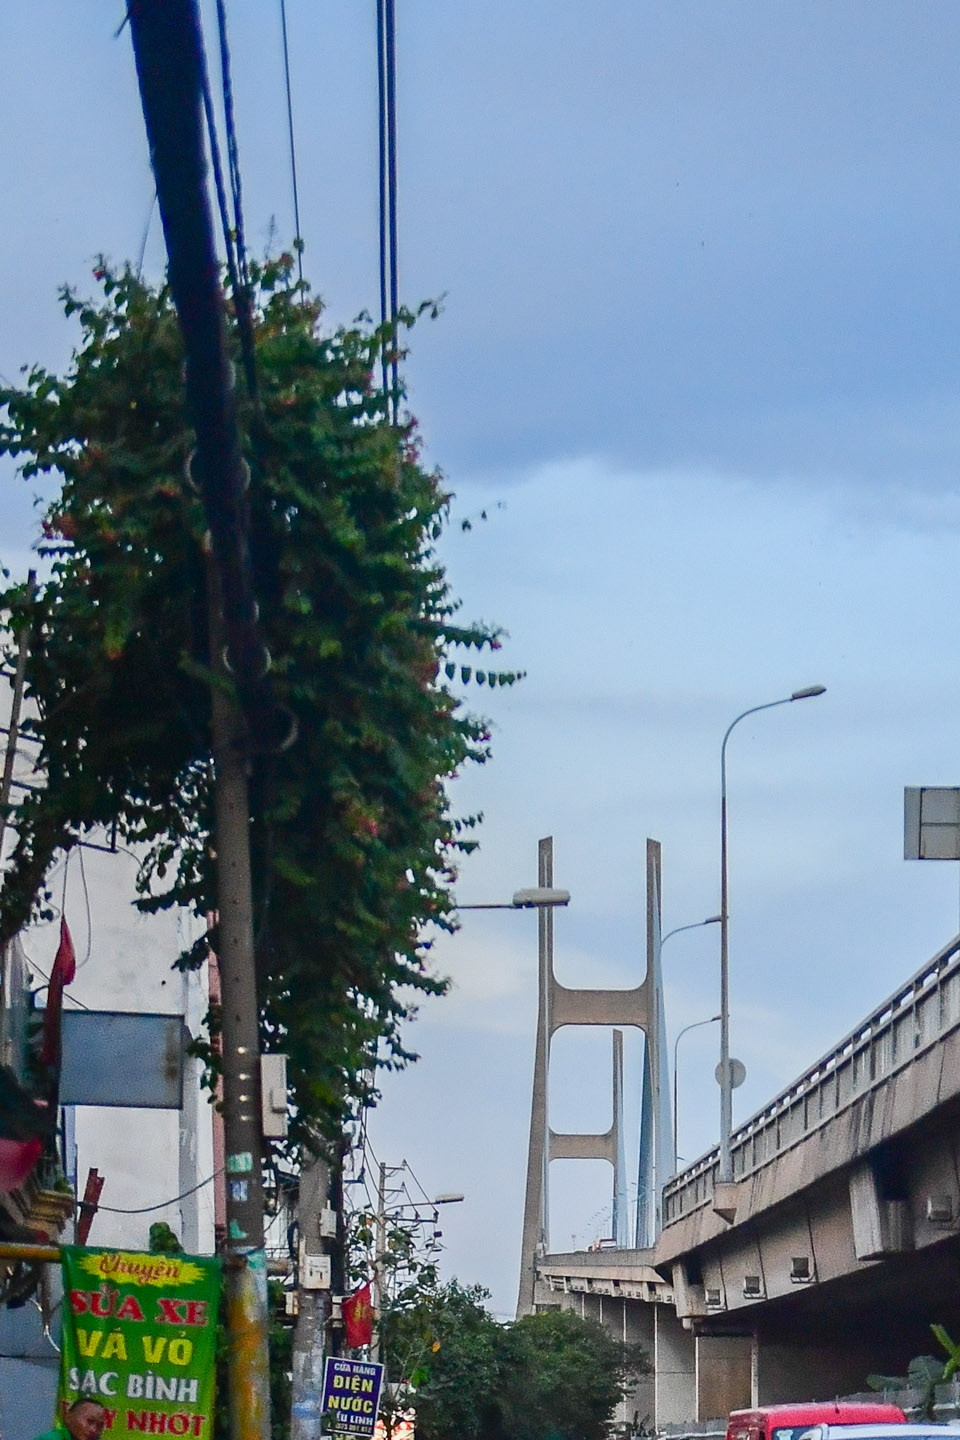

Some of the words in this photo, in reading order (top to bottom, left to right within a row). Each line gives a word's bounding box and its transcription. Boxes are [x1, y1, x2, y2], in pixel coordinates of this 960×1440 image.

[100, 1253, 180, 1285] Chuyên
[70, 1283, 145, 1321] SỬA
[155, 1298, 208, 1326] XE
[76, 1327, 128, 1361] VÁ
[142, 1330, 193, 1366] VỎ
[334, 1361, 351, 1373] CỬA
[353, 1364, 376, 1376] HÀNG
[69, 1367, 119, 1398] SẠC
[127, 1370, 199, 1403] BÌNH
[333, 1374, 374, 1394] ĐIỆN
[328, 1395, 373, 1414] NƯỚC
[127, 1408, 206, 1437] NHỚT
[350, 1415, 374, 1426] LINH
